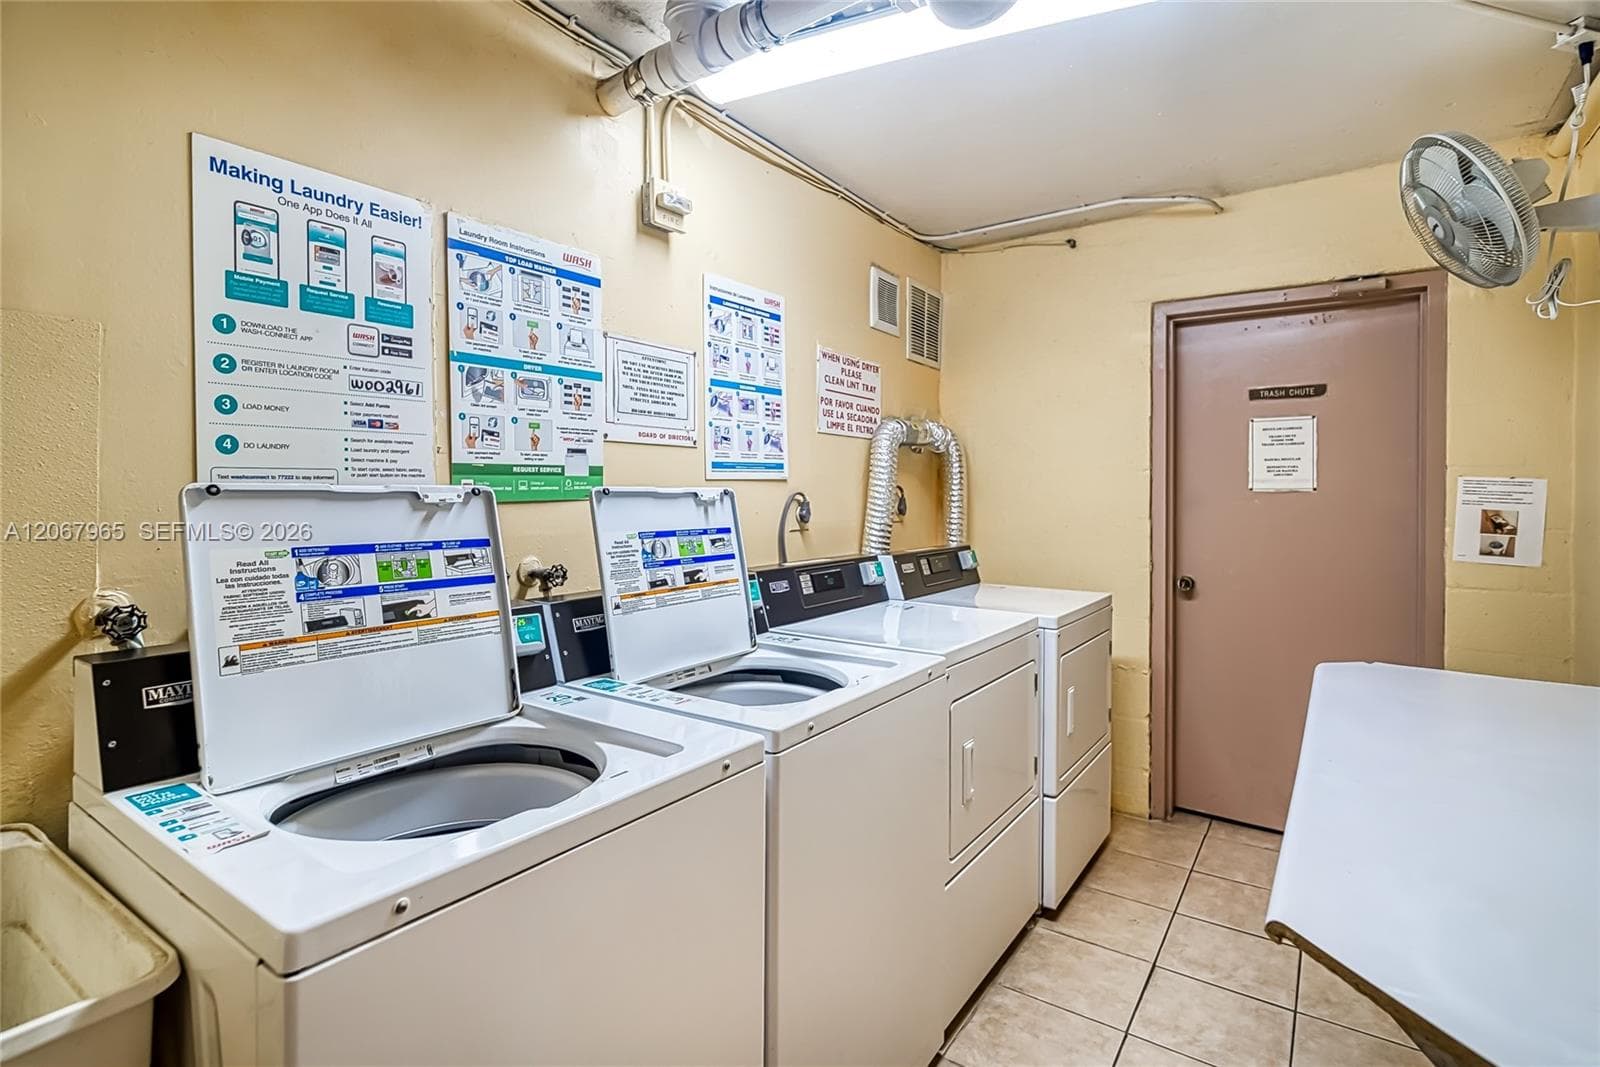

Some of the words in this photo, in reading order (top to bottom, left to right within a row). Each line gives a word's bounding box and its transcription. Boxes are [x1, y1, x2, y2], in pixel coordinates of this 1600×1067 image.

[209, 156, 283, 194] Making
[290, 179, 364, 215] Laundry
[369, 202, 422, 229] Easier!
[277, 196, 299, 210] One
[302, 203, 323, 217] App
[325, 209, 350, 223] Does
[353, 216, 359, 224] It
[361, 217, 372, 229] All
[459, 228, 487, 243] Laundry
[489, 236, 508, 248] Room
[509, 243, 546, 259] Instructions
[505, 256, 517, 265] TOP
[518, 260, 533, 270] LOAD
[534, 263, 557, 275] WASHER
[563, 252, 593, 271] WASH
[256, 278, 281, 288] Payment
[763, 297, 781, 309] WASH
[221, 318, 228, 329] 1
[241, 321, 283, 333] DOWNLOAD
[241, 328, 299, 341] WASH-CONNECT
[353, 333, 376, 342] WASH
[220, 358, 229, 369] 2
[242, 360, 276, 368] REGISTER
[286, 364, 318, 373] LAUNDRY
[319, 367, 340, 375] ROOM
[821, 351, 841, 363] WHEN
[842, 357, 860, 369] USING
[862, 362, 880, 374] DRYER
[254, 367, 277, 375] ENTER
[278, 370, 312, 378] LOCATION
[841, 368, 863, 380] PLEASE
[824, 374, 846, 388] CLEAN
[847, 379, 860, 391] LINT
[862, 383, 877, 394] TRAY
[1260, 389, 1285, 398] TRASH
[1288, 387, 1316, 396] CHUTE
[221, 398, 230, 410] 3
[242, 403, 262, 411] LOAD
[263, 404, 290, 413] MONEY
[820, 396, 834, 407] POR
[835, 399, 854, 411] FAVOR
[856, 403, 881, 416] CUANDO
[822, 408, 834, 418] USE
[836, 411, 845, 420] LA
[847, 413, 878, 426] SECADORA
[827, 421, 846, 432] LIMPIE
[847, 424, 854, 432] EL
[856, 425, 874, 435] FILTRO
[222, 438, 232, 449] 4
[638, 431, 658, 440] BOARD
[668, 434, 694, 442] DIRECTORS
[513, 466, 539, 474] REQUEST
[540, 466, 562, 474] SERVICE
[230, 566, 277, 575] Instructions
[244, 574, 270, 582] cuidado
